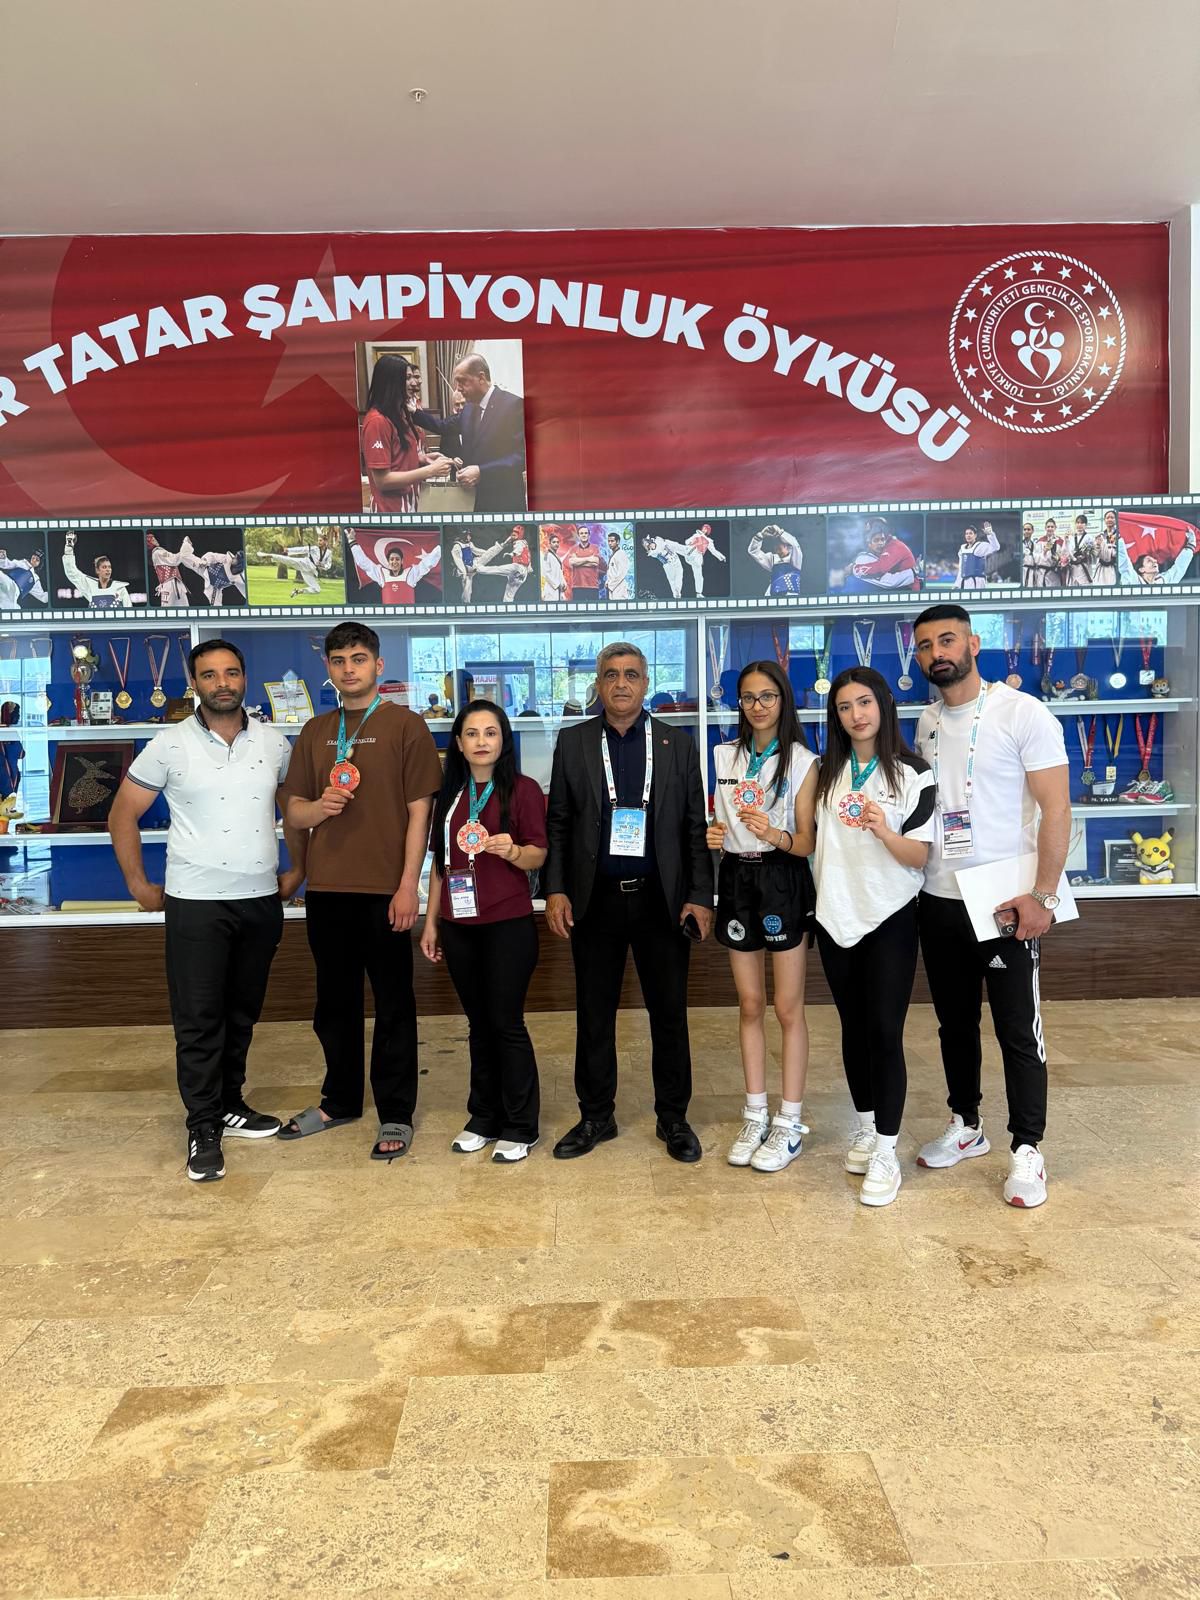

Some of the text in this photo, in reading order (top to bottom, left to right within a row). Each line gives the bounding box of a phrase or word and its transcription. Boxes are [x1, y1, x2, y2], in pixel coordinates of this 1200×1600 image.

[22, 295, 234, 395] TATAR
[243, 262, 714, 350] ŞAMPİYONLUK
[723, 302, 972, 462] ÖYKÜSÜ
[981, 284, 1094, 398] TÜRKİYE CUMHURİYETİ GENÇLİK VE SPOR BAKANLIĞI
